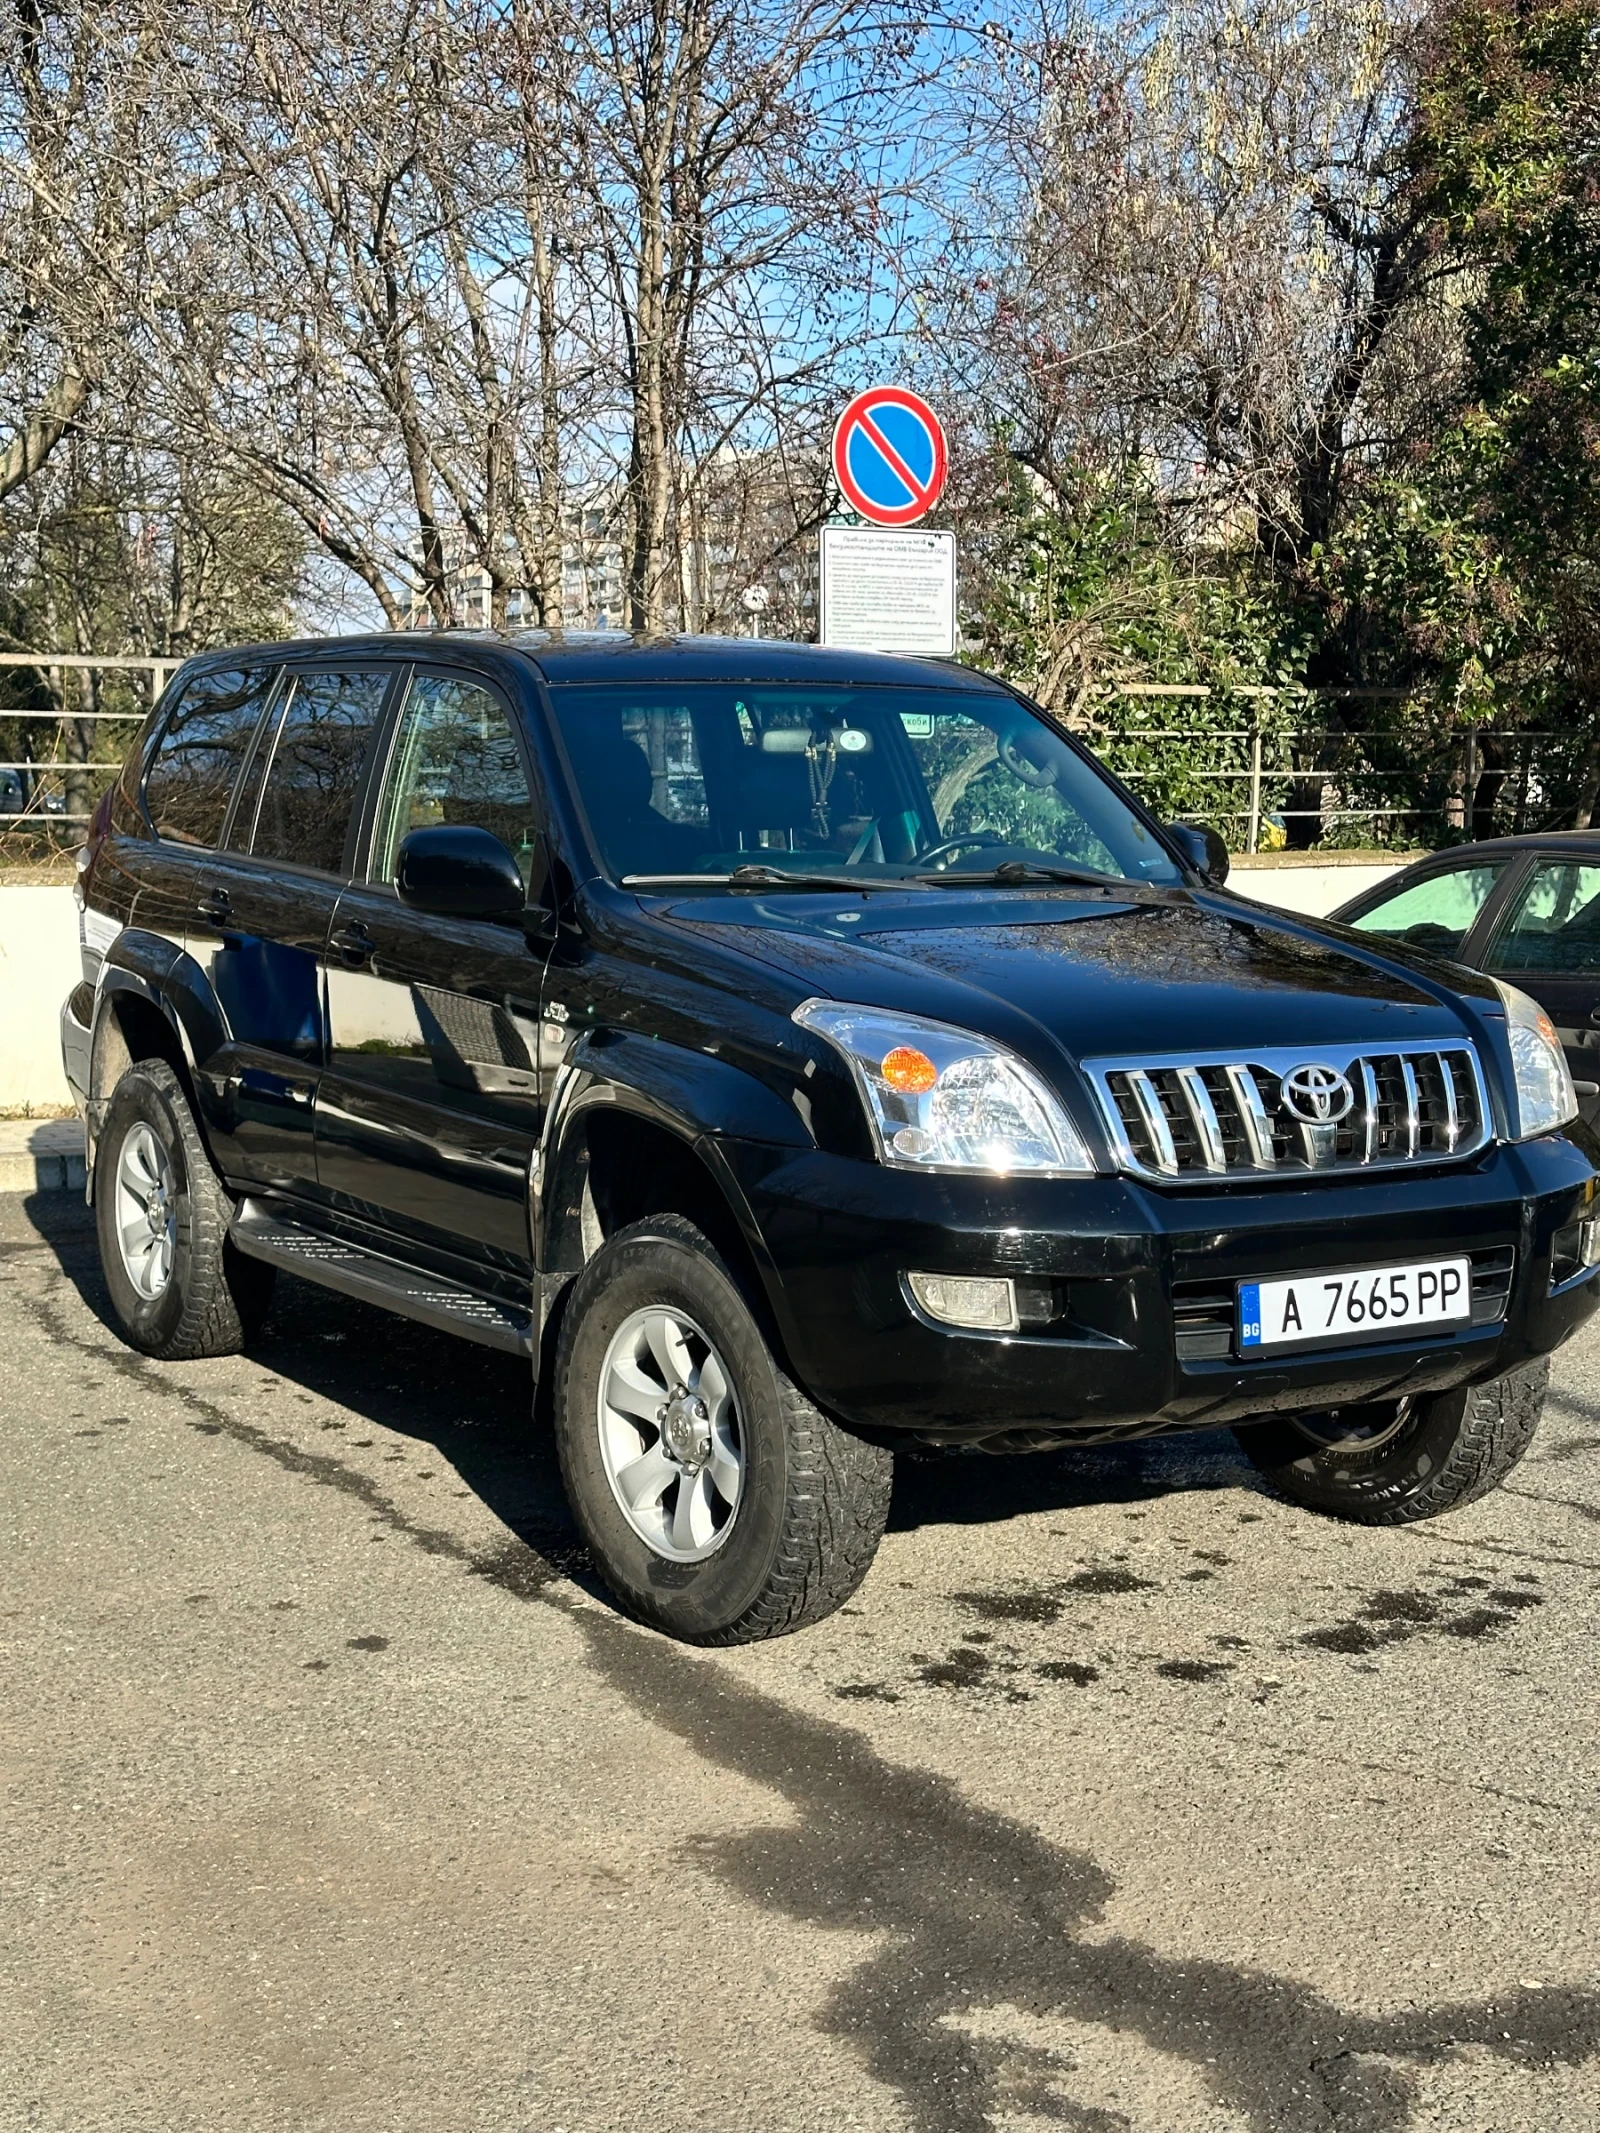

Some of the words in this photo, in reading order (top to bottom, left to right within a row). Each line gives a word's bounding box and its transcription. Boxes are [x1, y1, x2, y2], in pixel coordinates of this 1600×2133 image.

[1281, 1288, 1303, 1333] A
[1323, 1274, 1409, 1328] 7665
[1242, 1322, 1260, 1339] BG
